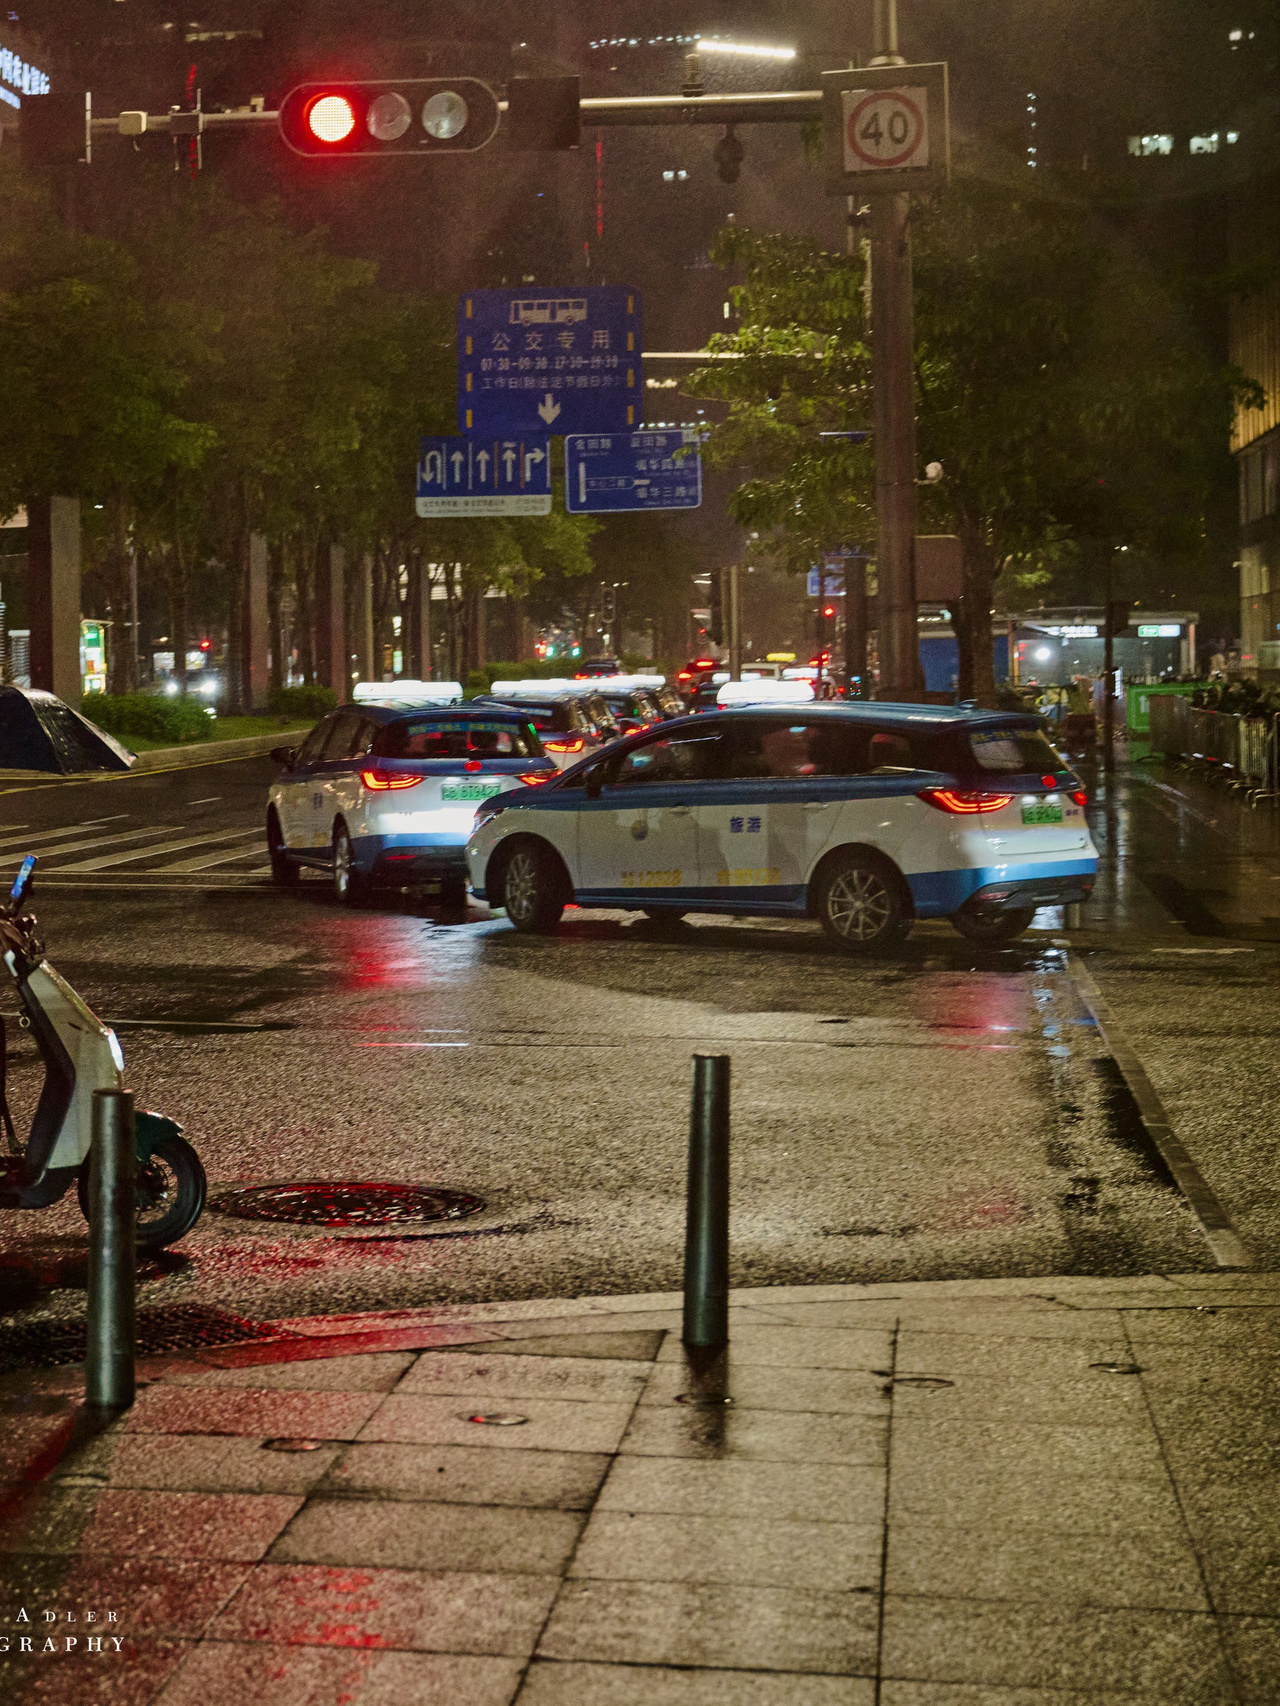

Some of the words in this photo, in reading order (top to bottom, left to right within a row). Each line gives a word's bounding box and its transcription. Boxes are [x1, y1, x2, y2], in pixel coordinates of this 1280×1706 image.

[860, 110, 908, 146] 40
[491, 329, 610, 351] 公交专用
